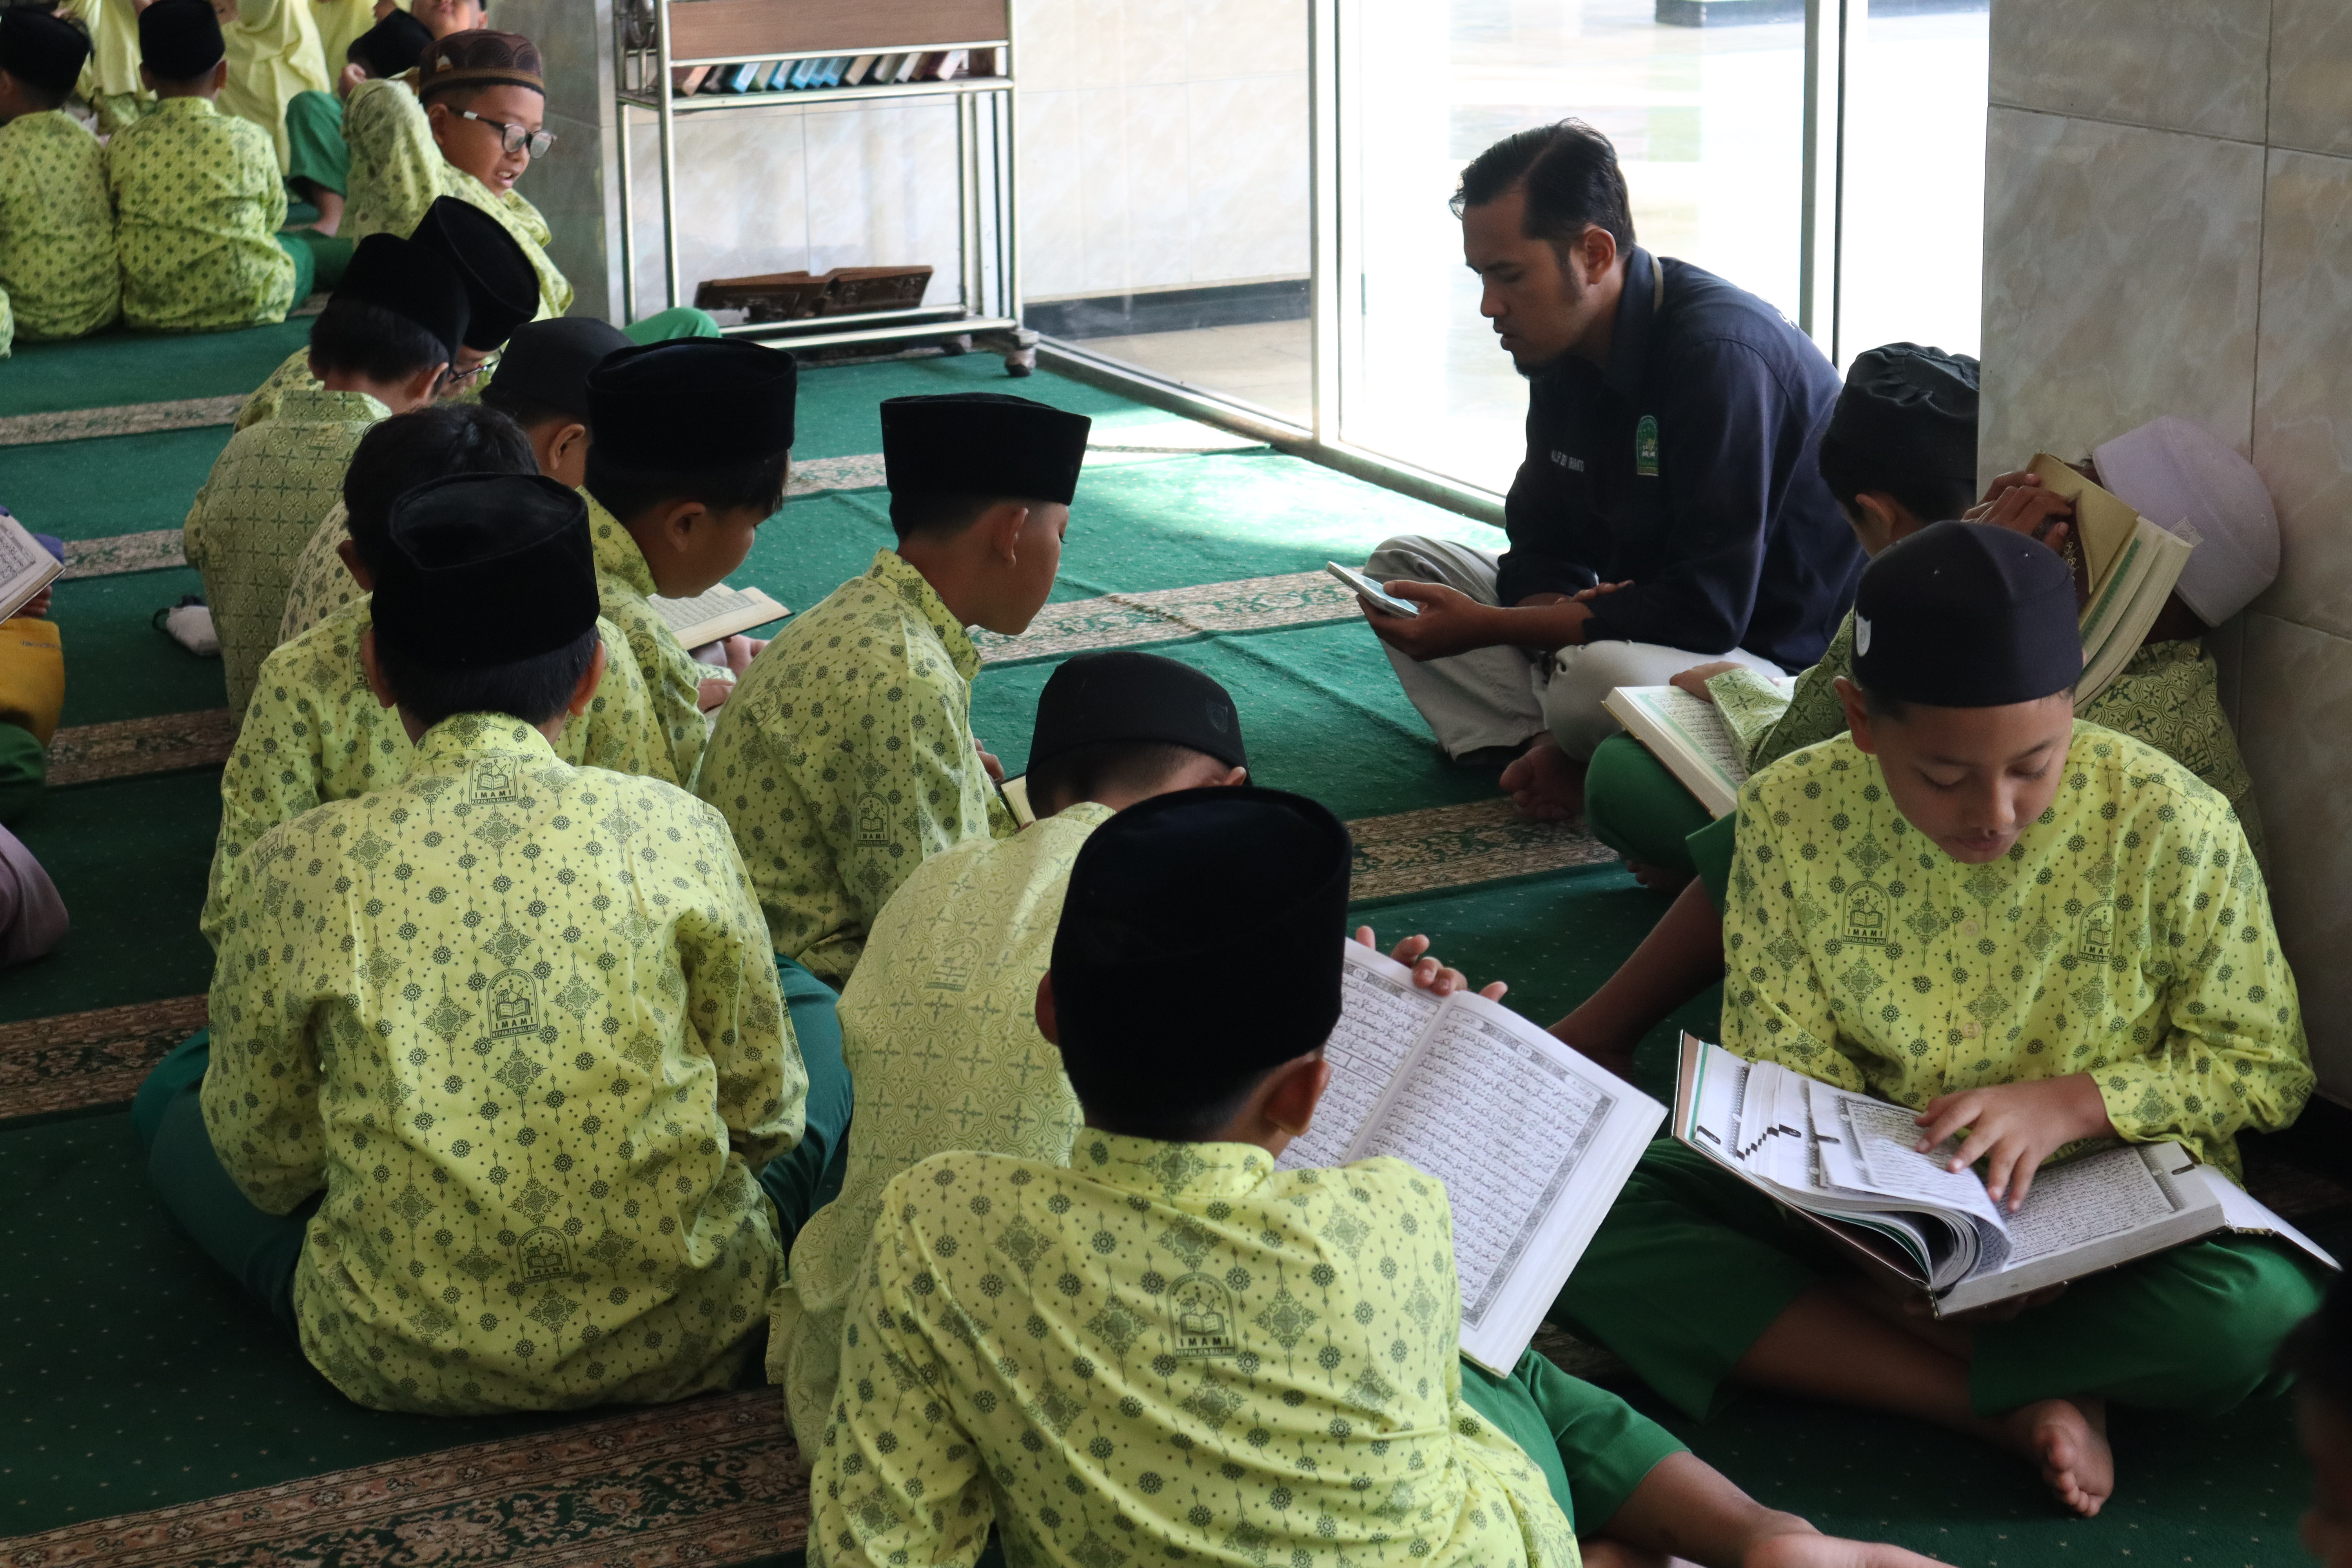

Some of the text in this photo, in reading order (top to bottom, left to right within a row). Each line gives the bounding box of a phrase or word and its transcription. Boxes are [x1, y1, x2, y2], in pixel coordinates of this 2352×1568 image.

[475, 789, 511, 798] IMAMI
[1848, 928, 1882, 937] IMAMI
[2084, 946, 2110, 954] IMA
[491, 973, 510, 990] MADRASAH
[495, 1016, 533, 1029] IMAMI
[528, 1267, 566, 1276] IMAMI
[1180, 1337, 1229, 1347] IMAMI
